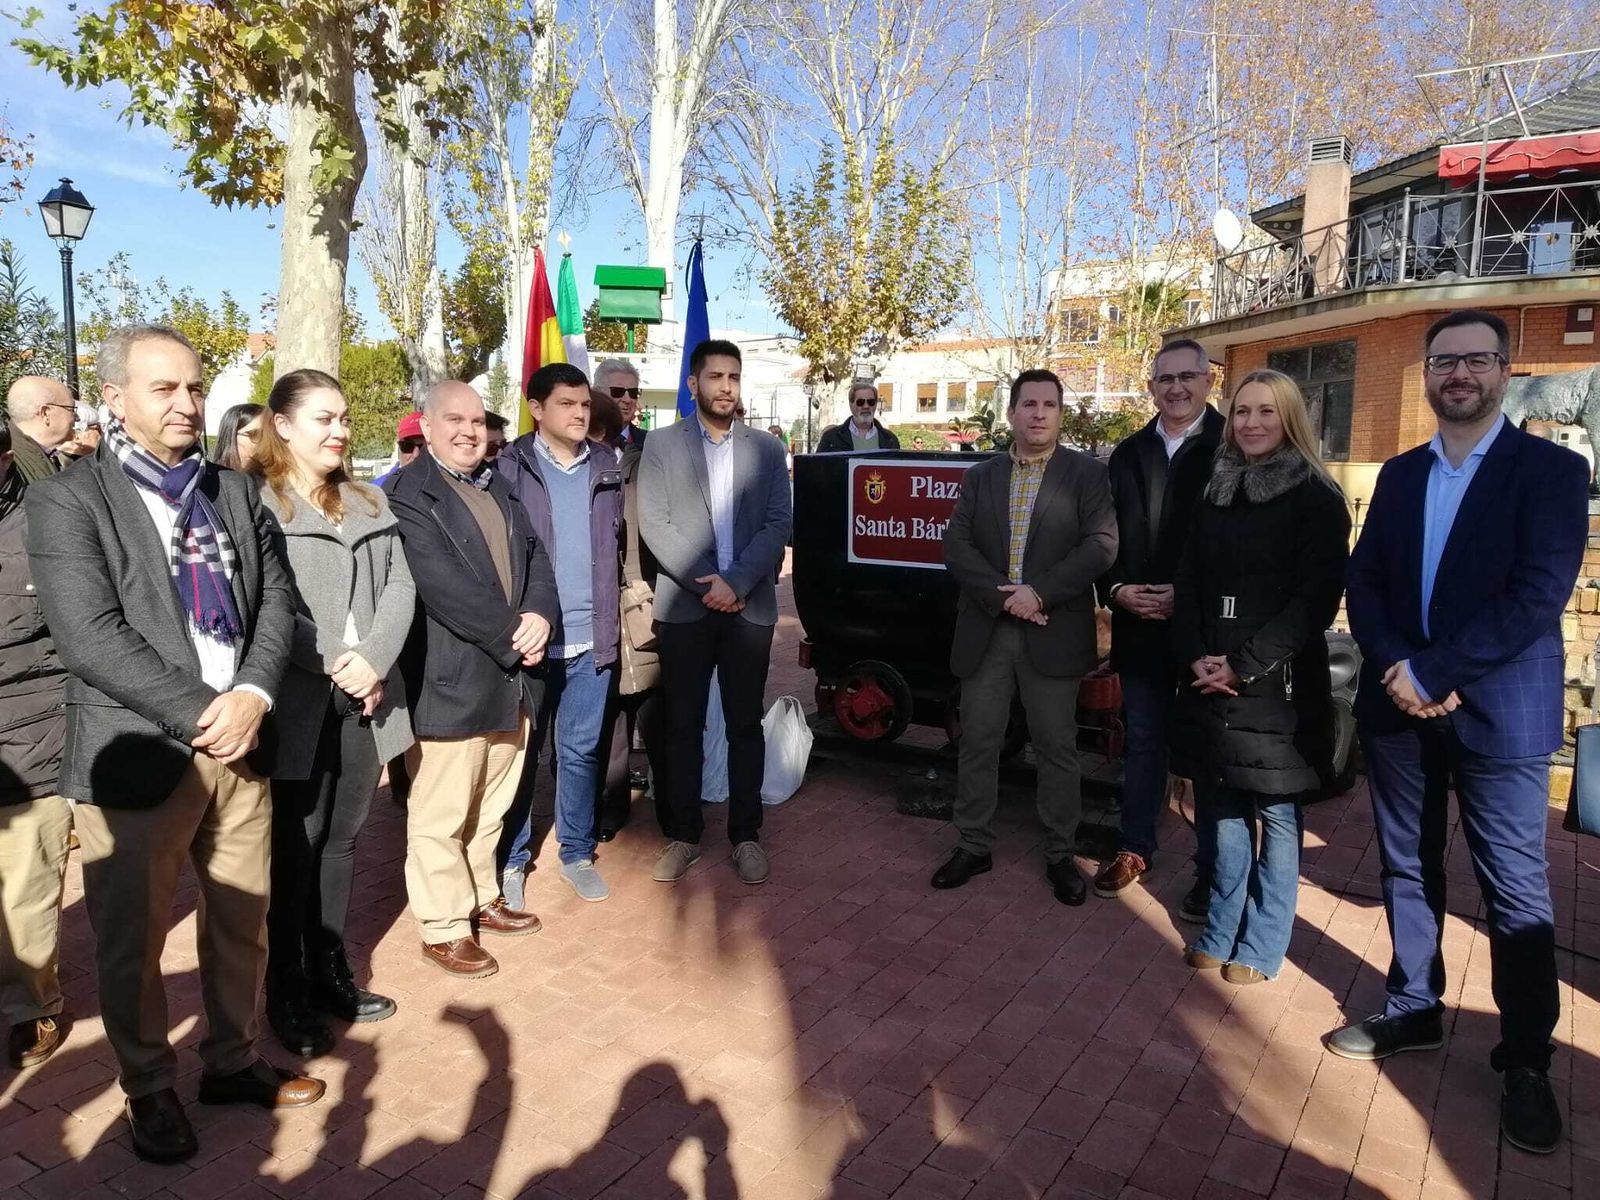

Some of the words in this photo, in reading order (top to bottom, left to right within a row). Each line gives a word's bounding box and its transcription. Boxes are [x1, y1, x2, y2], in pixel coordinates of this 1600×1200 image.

[910, 475, 962, 499] Plaz
[855, 514, 907, 538] Santa
[911, 516, 951, 541] Bár
